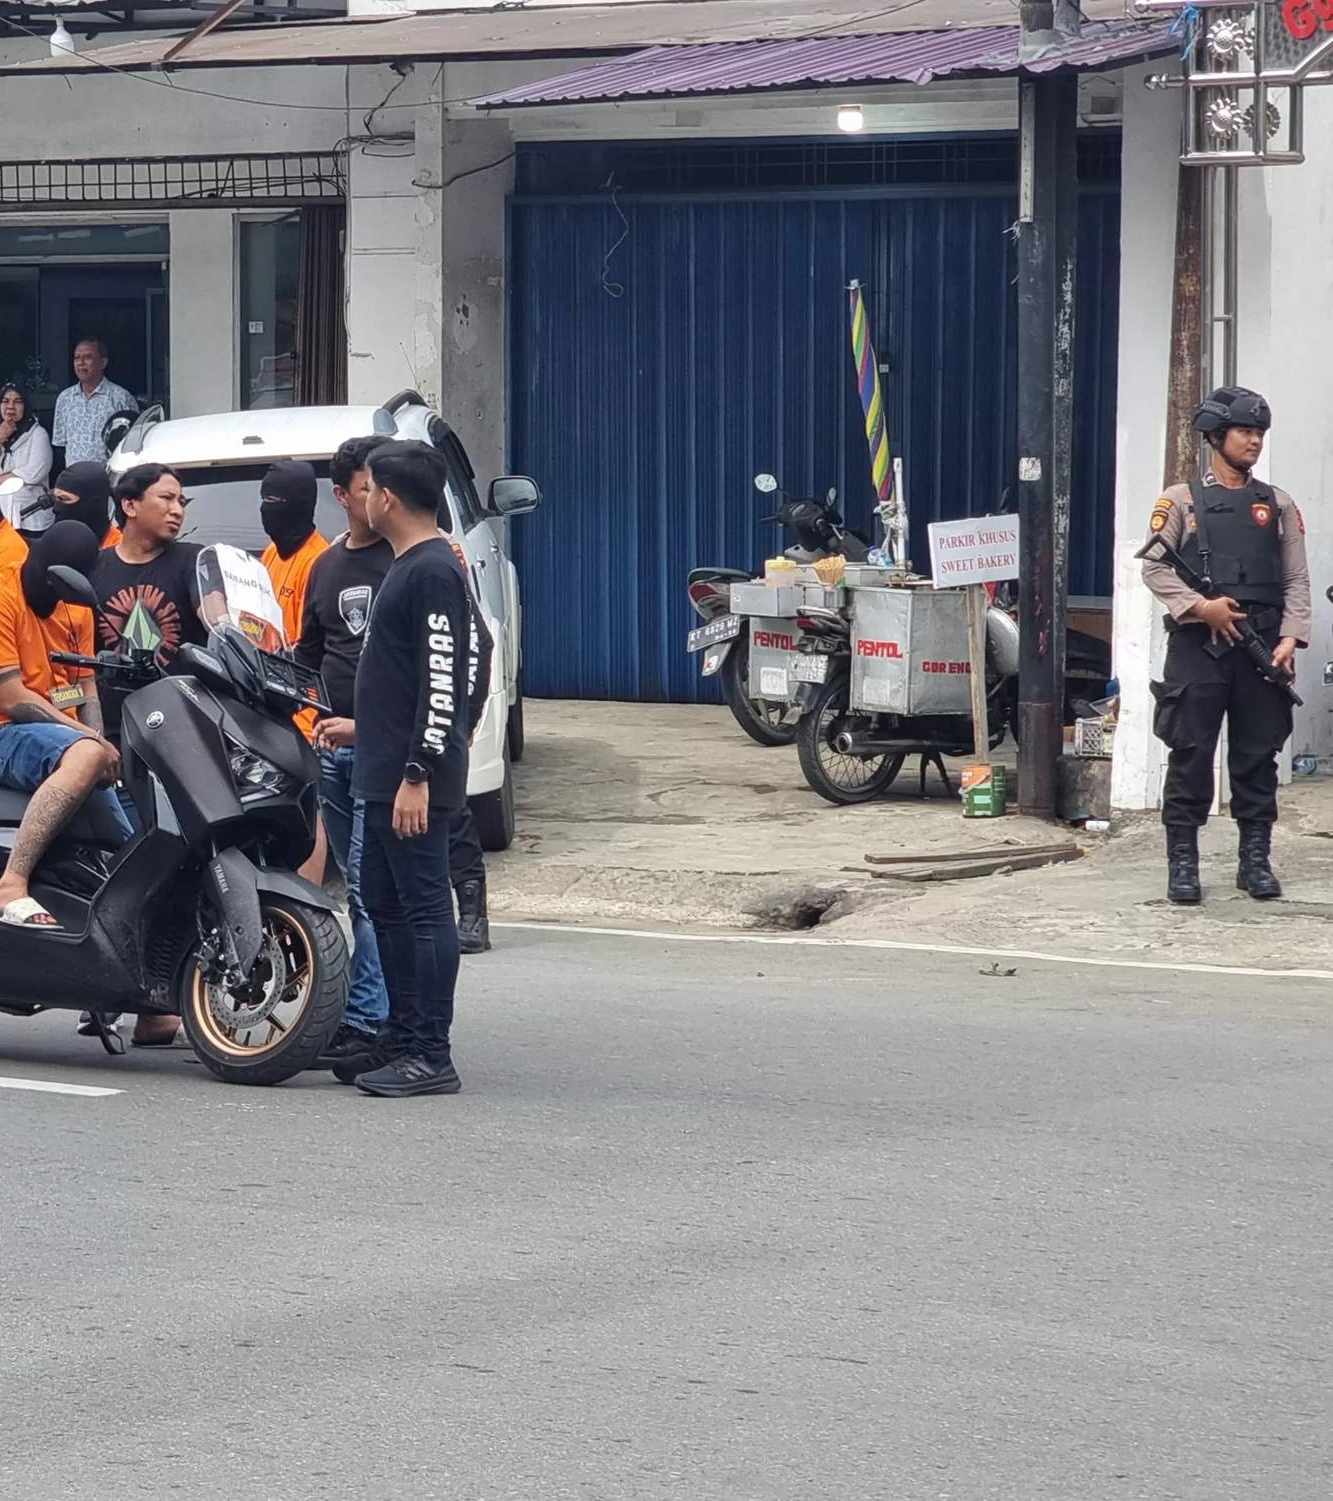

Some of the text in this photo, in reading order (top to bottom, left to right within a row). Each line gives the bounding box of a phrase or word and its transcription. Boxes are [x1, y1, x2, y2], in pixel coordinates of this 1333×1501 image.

[939, 529, 1016, 550] PARKIR KHUSUS
[941, 553, 1016, 574] SWEET BAKERY
[753, 631, 798, 651] PENTOL
[857, 639, 903, 659] PENTOL
[422, 613, 454, 755] JATANRAS
[214, 863, 229, 894] YAMAHA
